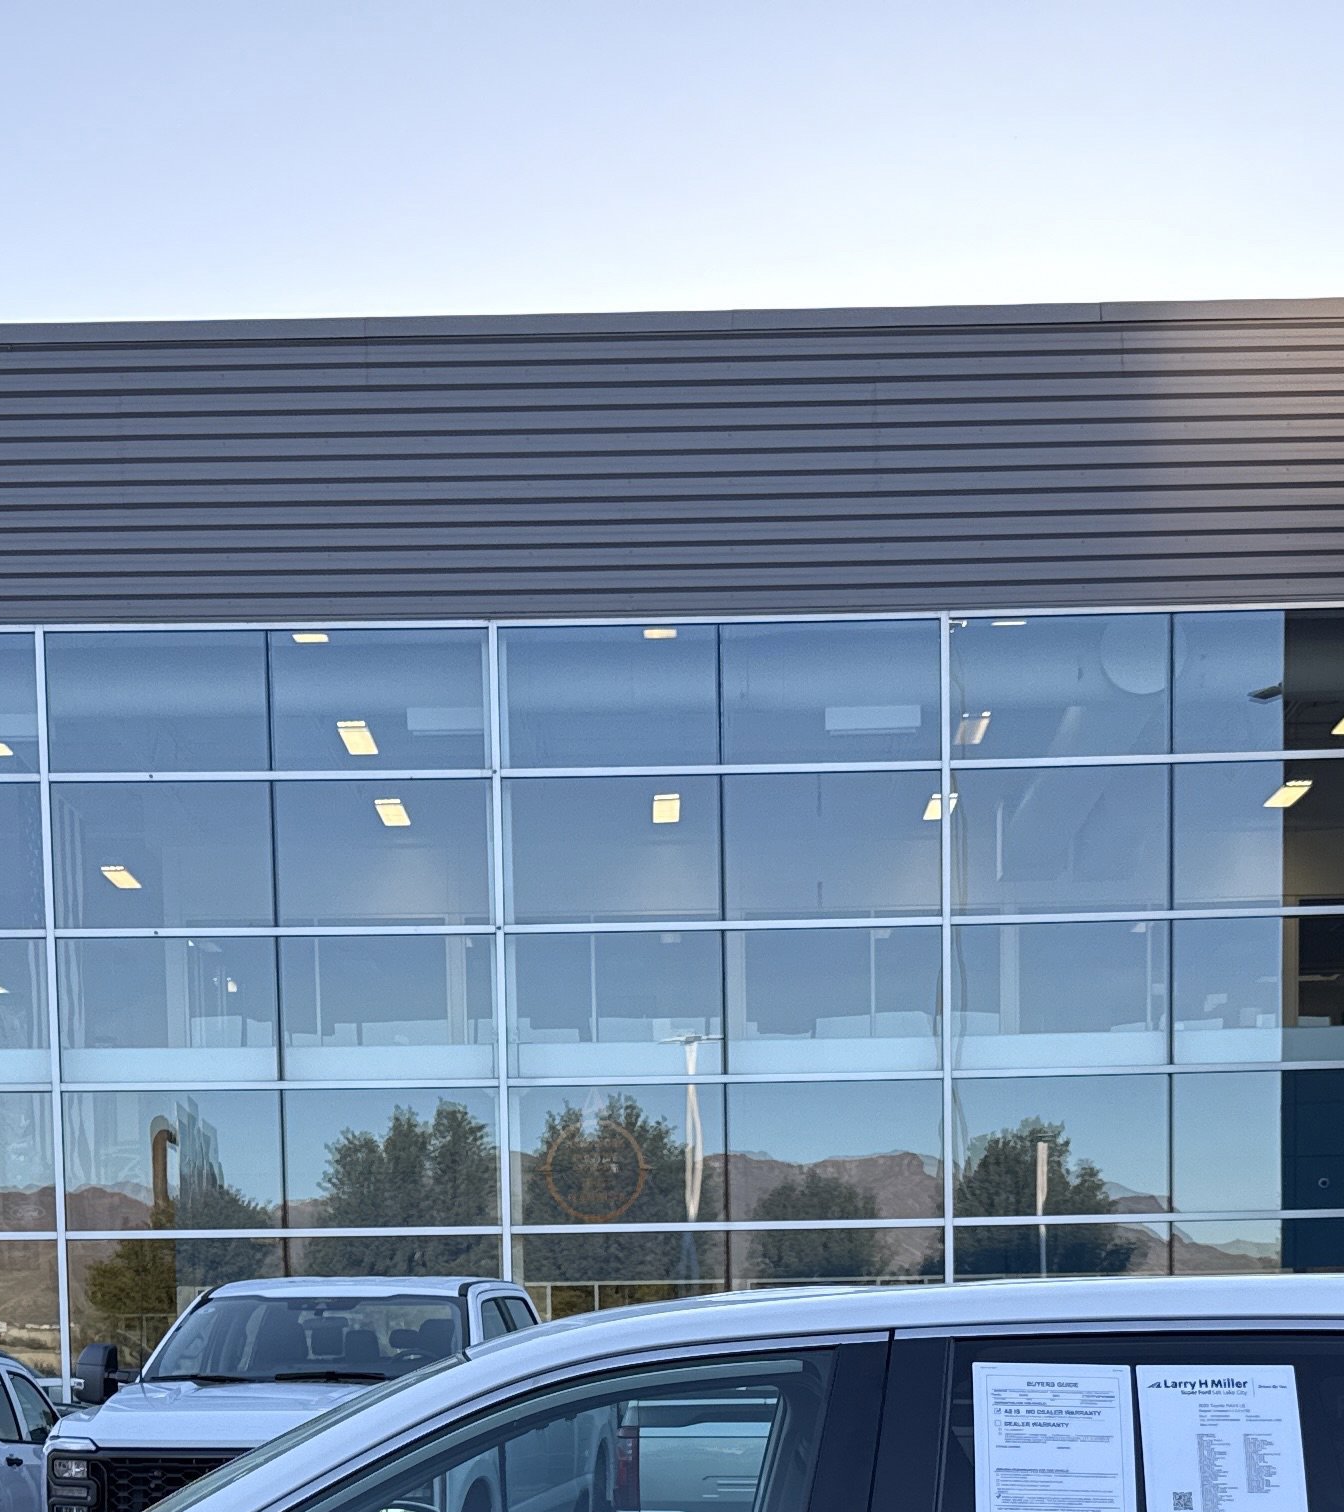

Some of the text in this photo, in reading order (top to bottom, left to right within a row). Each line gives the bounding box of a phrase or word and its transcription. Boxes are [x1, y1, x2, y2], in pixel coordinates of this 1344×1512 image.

[1163, 1378, 1248, 1390] Larry H Miller
